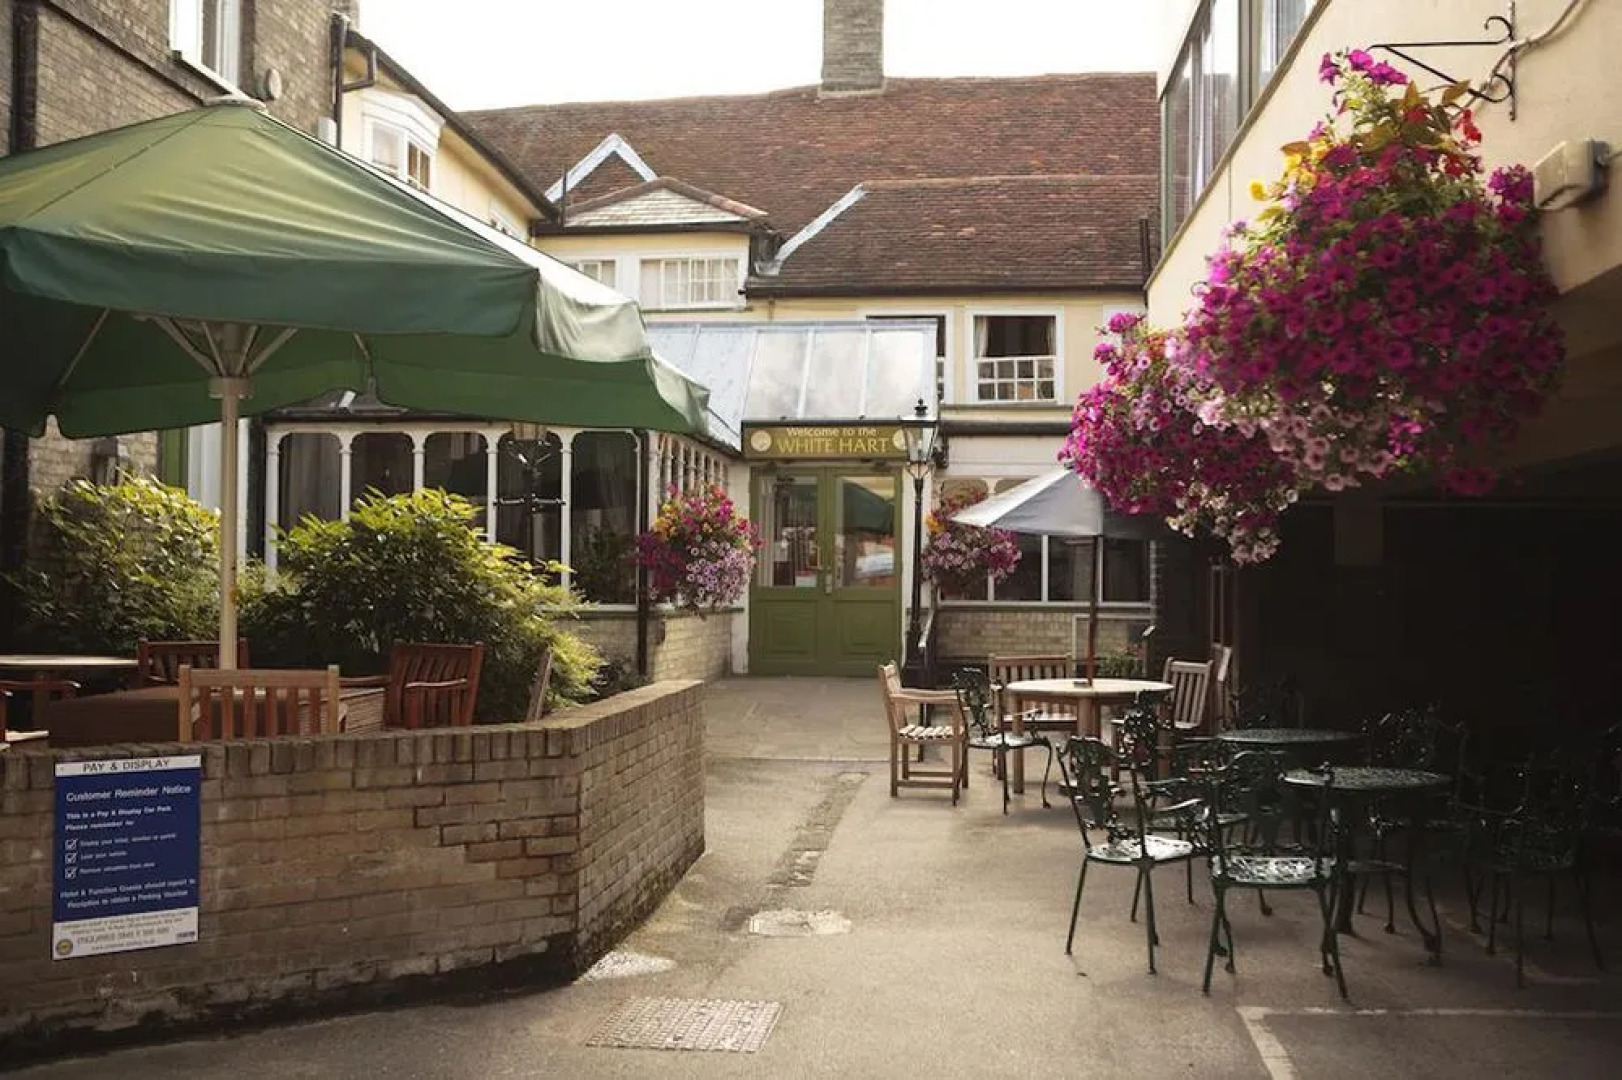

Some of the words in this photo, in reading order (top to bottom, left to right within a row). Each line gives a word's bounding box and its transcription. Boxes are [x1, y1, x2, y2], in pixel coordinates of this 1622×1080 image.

[786, 427, 840, 437] Welcome
[843, 427, 855, 437] to
[858, 427, 877, 437] the
[776, 437, 833, 453] WHITE
[839, 437, 889, 453] HART
[83, 763, 105, 773] PAY
[109, 762, 118, 771] &
[122, 759, 170, 771] DISPLAY
[66, 791, 112, 802] Customer
[114, 787, 159, 799] Reminder
[161, 785, 192, 795] Notice
[96, 810, 109, 818] Pay
[118, 808, 142, 816] Display
